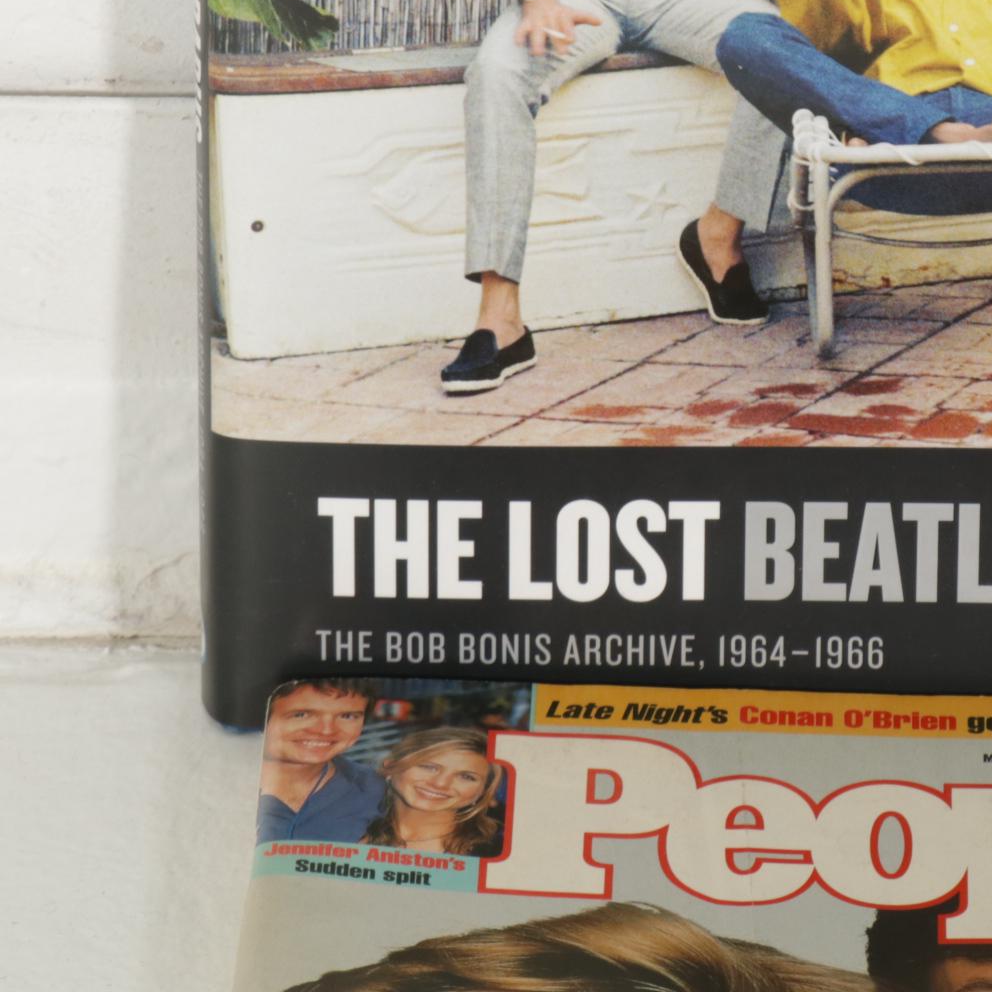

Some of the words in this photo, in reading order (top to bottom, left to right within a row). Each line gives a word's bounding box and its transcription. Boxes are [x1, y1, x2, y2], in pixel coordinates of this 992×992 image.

[317, 497, 484, 600] THE
[508, 498, 721, 603] LOST
[316, 629, 374, 664] THE
[385, 630, 447, 666] BOB
[458, 631, 552, 667] BONIS
[564, 633, 706, 671] ARCHIVE,
[545, 700, 615, 720] Late
[621, 702, 729, 725] Night's
[739, 705, 834, 728] Conan
[844, 709, 957, 731] O'Brien
[264, 842, 361, 859] Jennifer
[366, 847, 466, 871] Aniston's
[294, 859, 376, 880] Sudden
[383, 869, 431, 886] split
